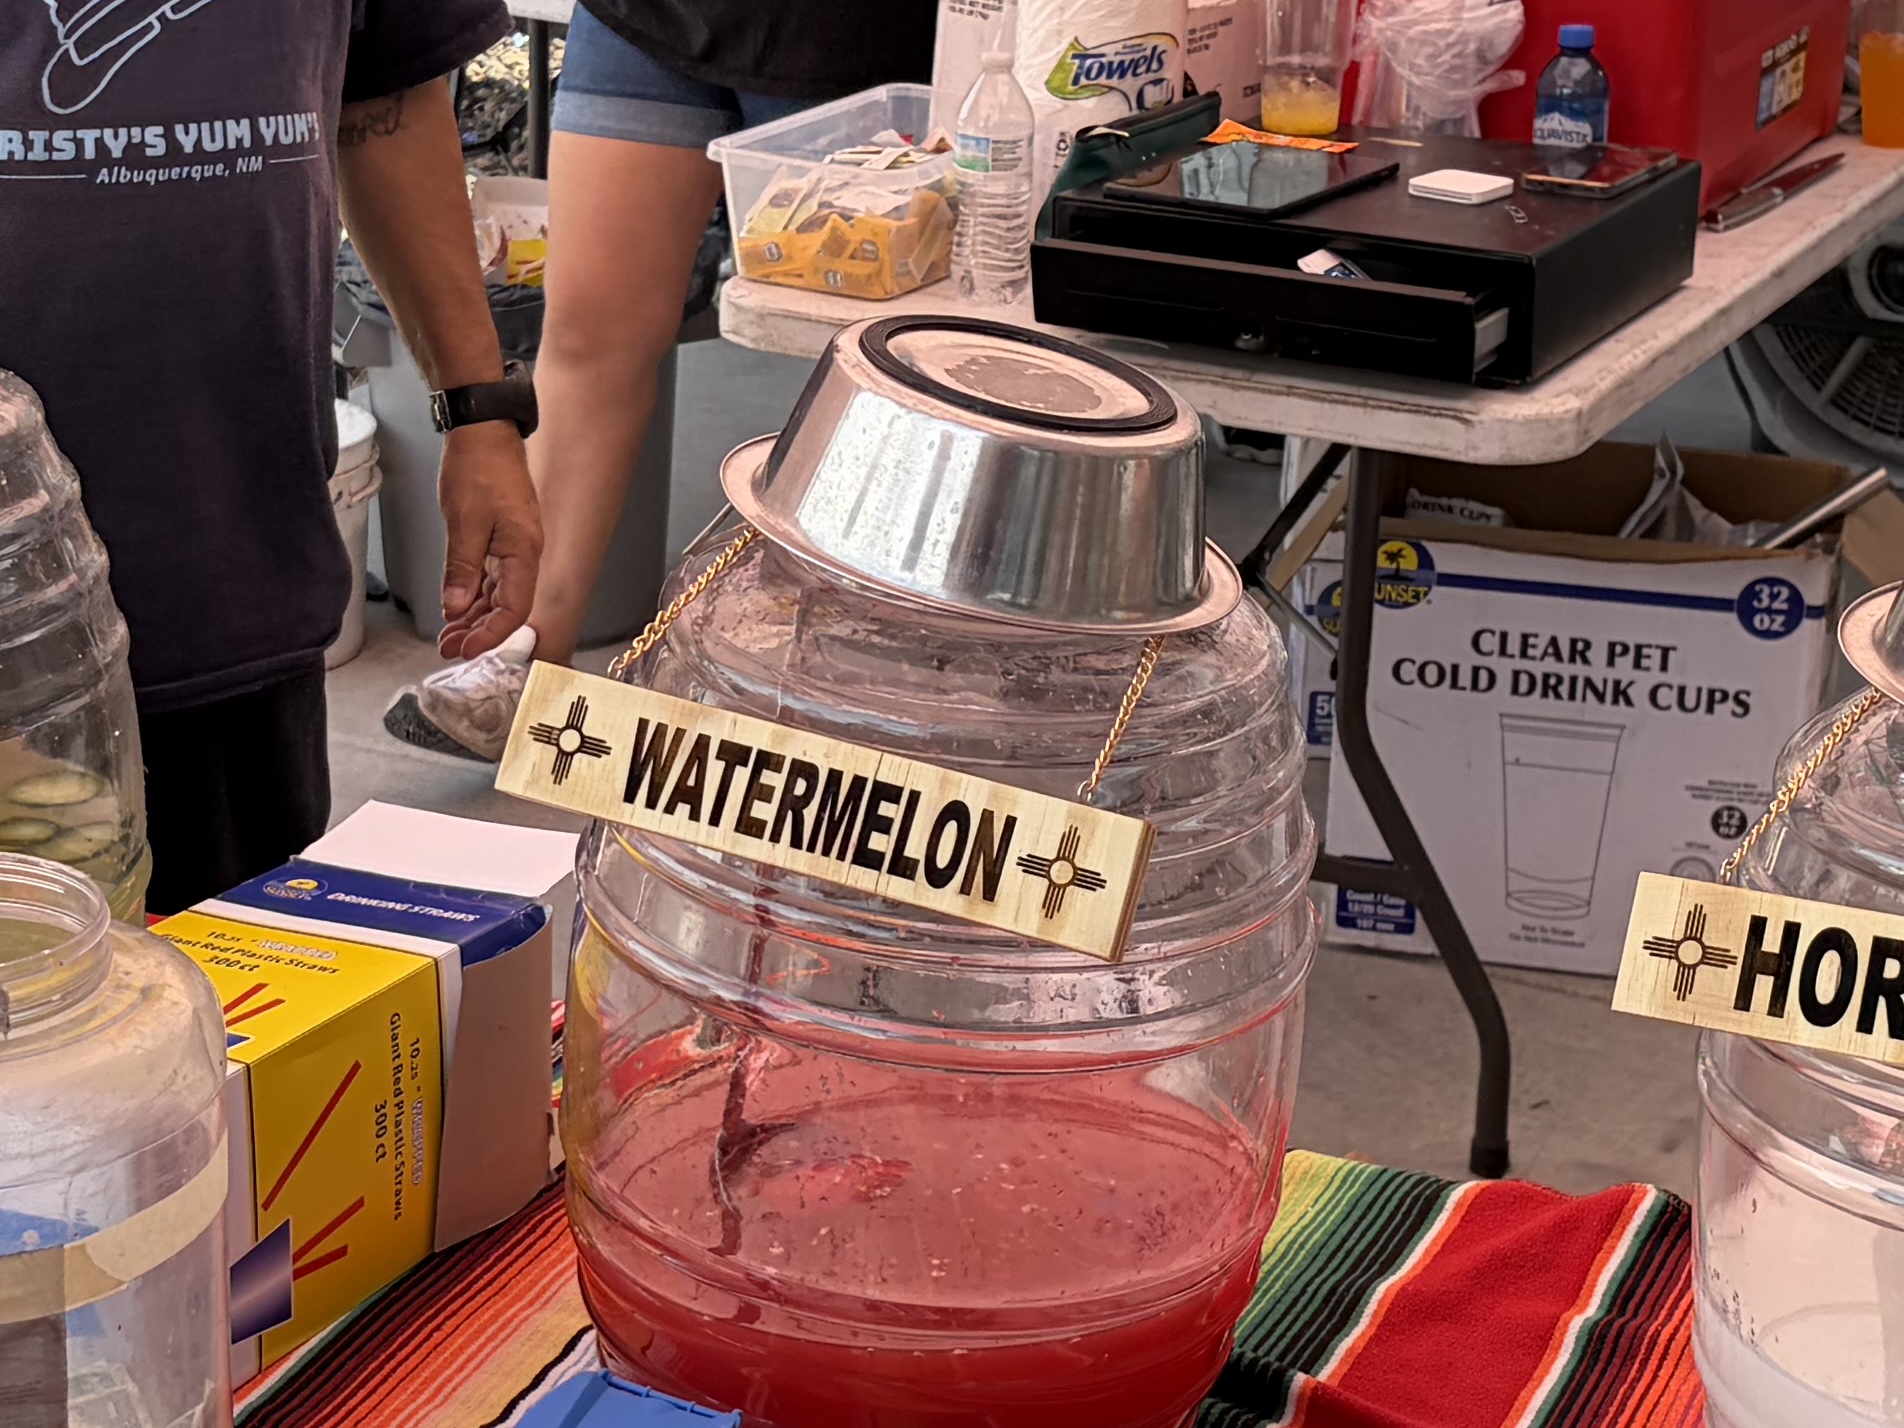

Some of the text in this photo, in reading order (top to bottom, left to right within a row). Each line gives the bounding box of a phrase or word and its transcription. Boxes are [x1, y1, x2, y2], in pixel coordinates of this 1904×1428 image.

[1070, 44, 1168, 88] Towels
[173, 118, 253, 155] YUM
[1533, 127, 1590, 144] QUAVISTA
[95, 155, 264, 186] Albuquerque, NM
[1374, 582, 1427, 604] UNSET
[1751, 582, 1791, 611] 32
[1470, 628, 1678, 674] CLEAR PET
[1391, 657, 1753, 719] COLD DRINK CUPS
[620, 715, 1019, 906] WATERMELON
[327, 891, 482, 923] DRINKING STRAWS
[202, 940, 235, 955] Red
[232, 945, 284, 965] Plastic
[285, 957, 341, 975] Straws
[203, 954, 241, 969] 300
[373, 1099, 389, 1164] 300 ct
[389, 1011, 406, 1222] Giant Red Plastic Straws
